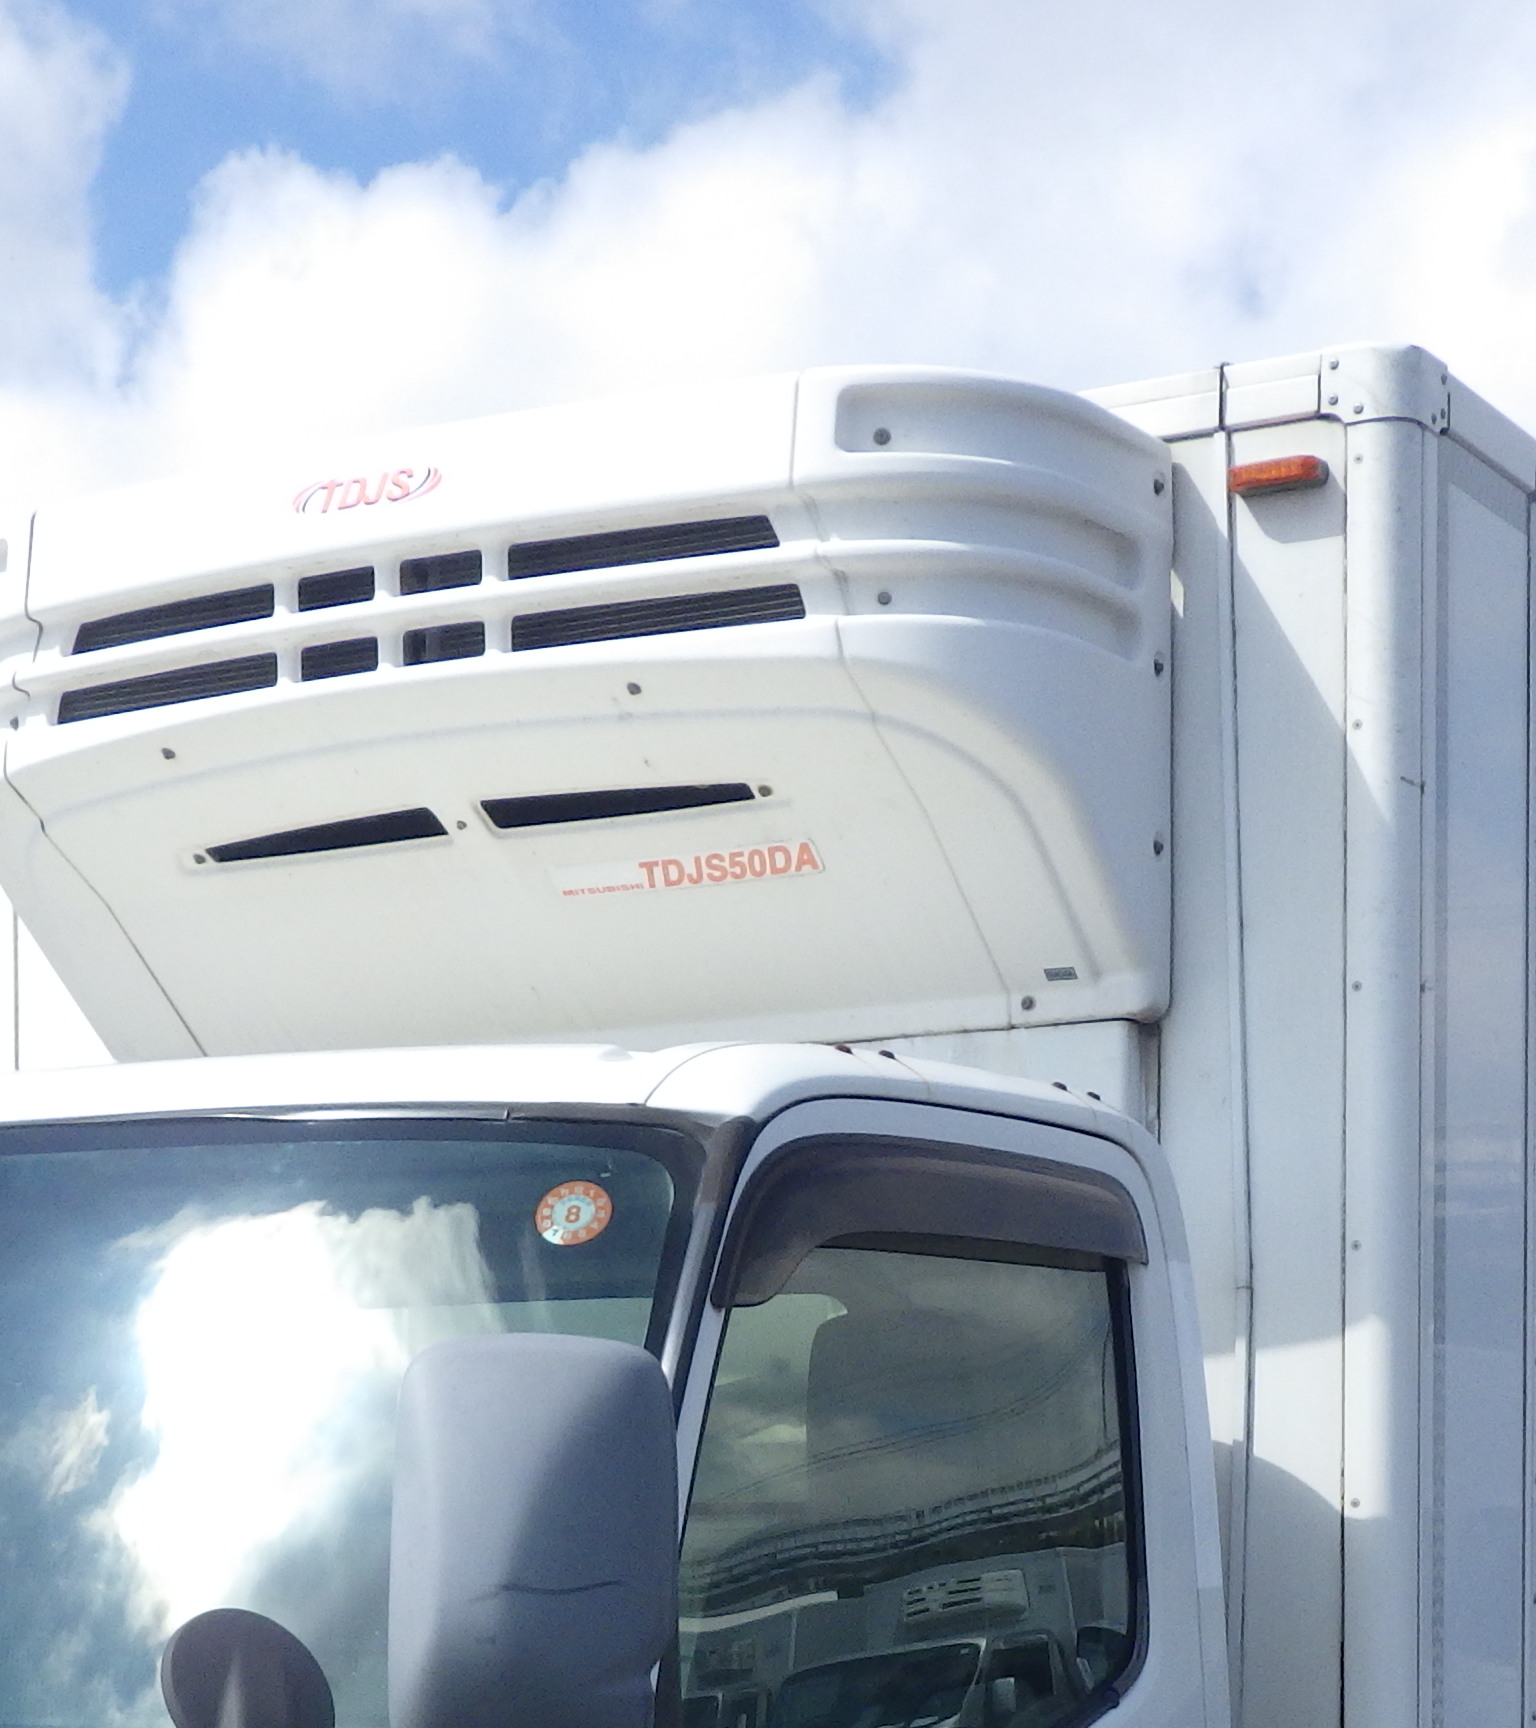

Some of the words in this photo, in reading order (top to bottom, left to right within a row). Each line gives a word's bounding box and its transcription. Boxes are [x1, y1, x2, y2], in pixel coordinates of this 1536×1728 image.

[319, 468, 413, 513] TDJS
[638, 842, 819, 888] TDJS50DA
[565, 1205, 581, 1223] 8
